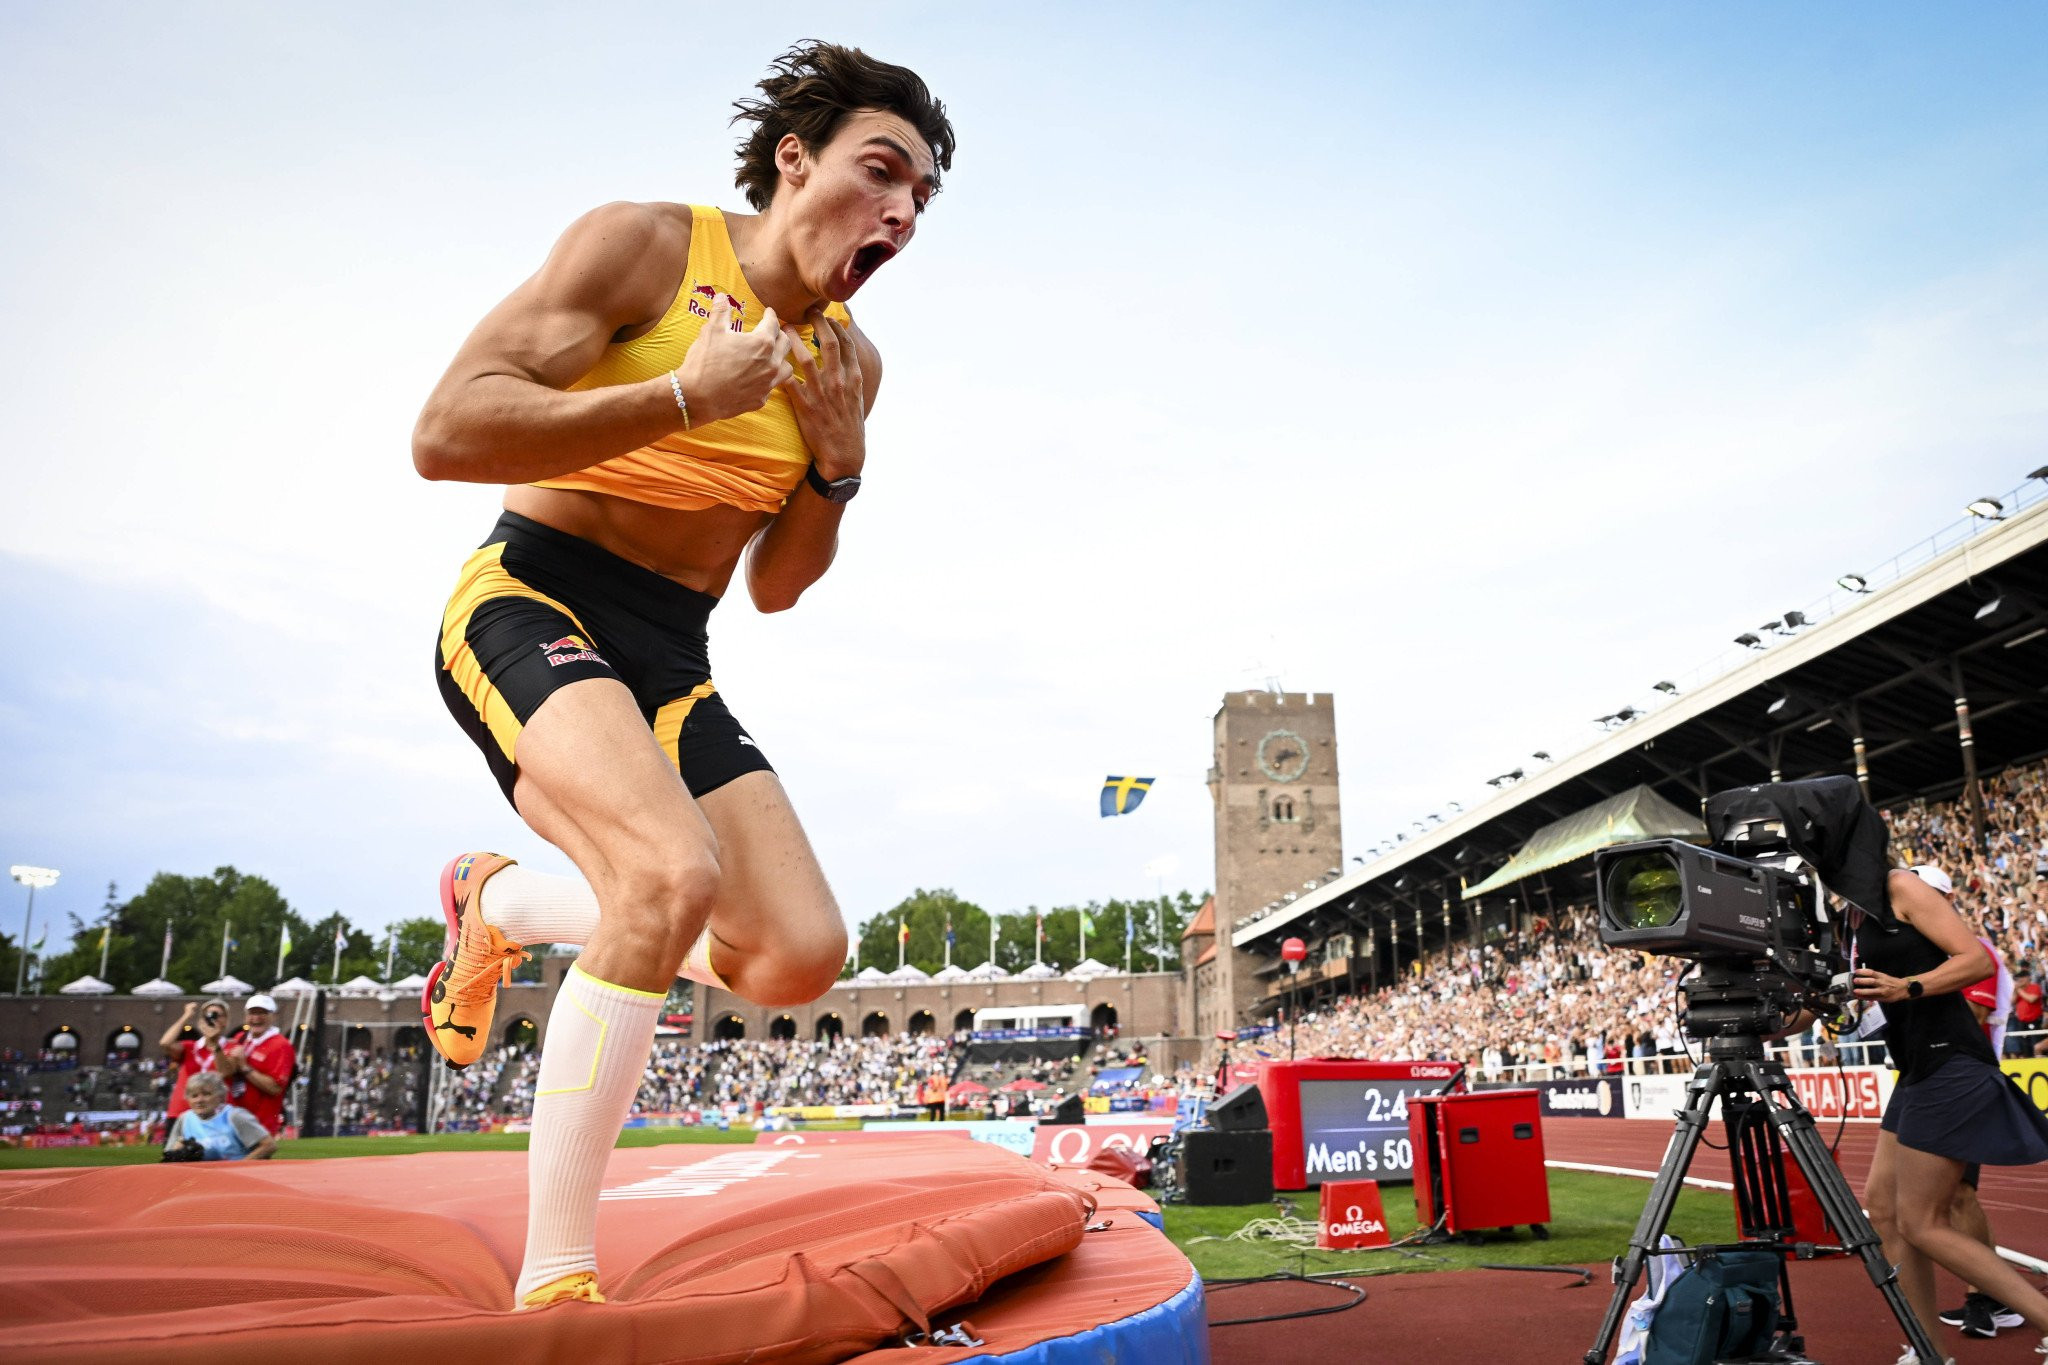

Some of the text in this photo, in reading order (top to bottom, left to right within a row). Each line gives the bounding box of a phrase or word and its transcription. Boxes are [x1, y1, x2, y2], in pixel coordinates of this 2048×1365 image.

[547, 650, 592, 667] Red
[1799, 1076, 1878, 1113] HAUS
[1306, 1140, 1378, 1174] Men's
[1329, 1220, 1384, 1237] OMEGA
